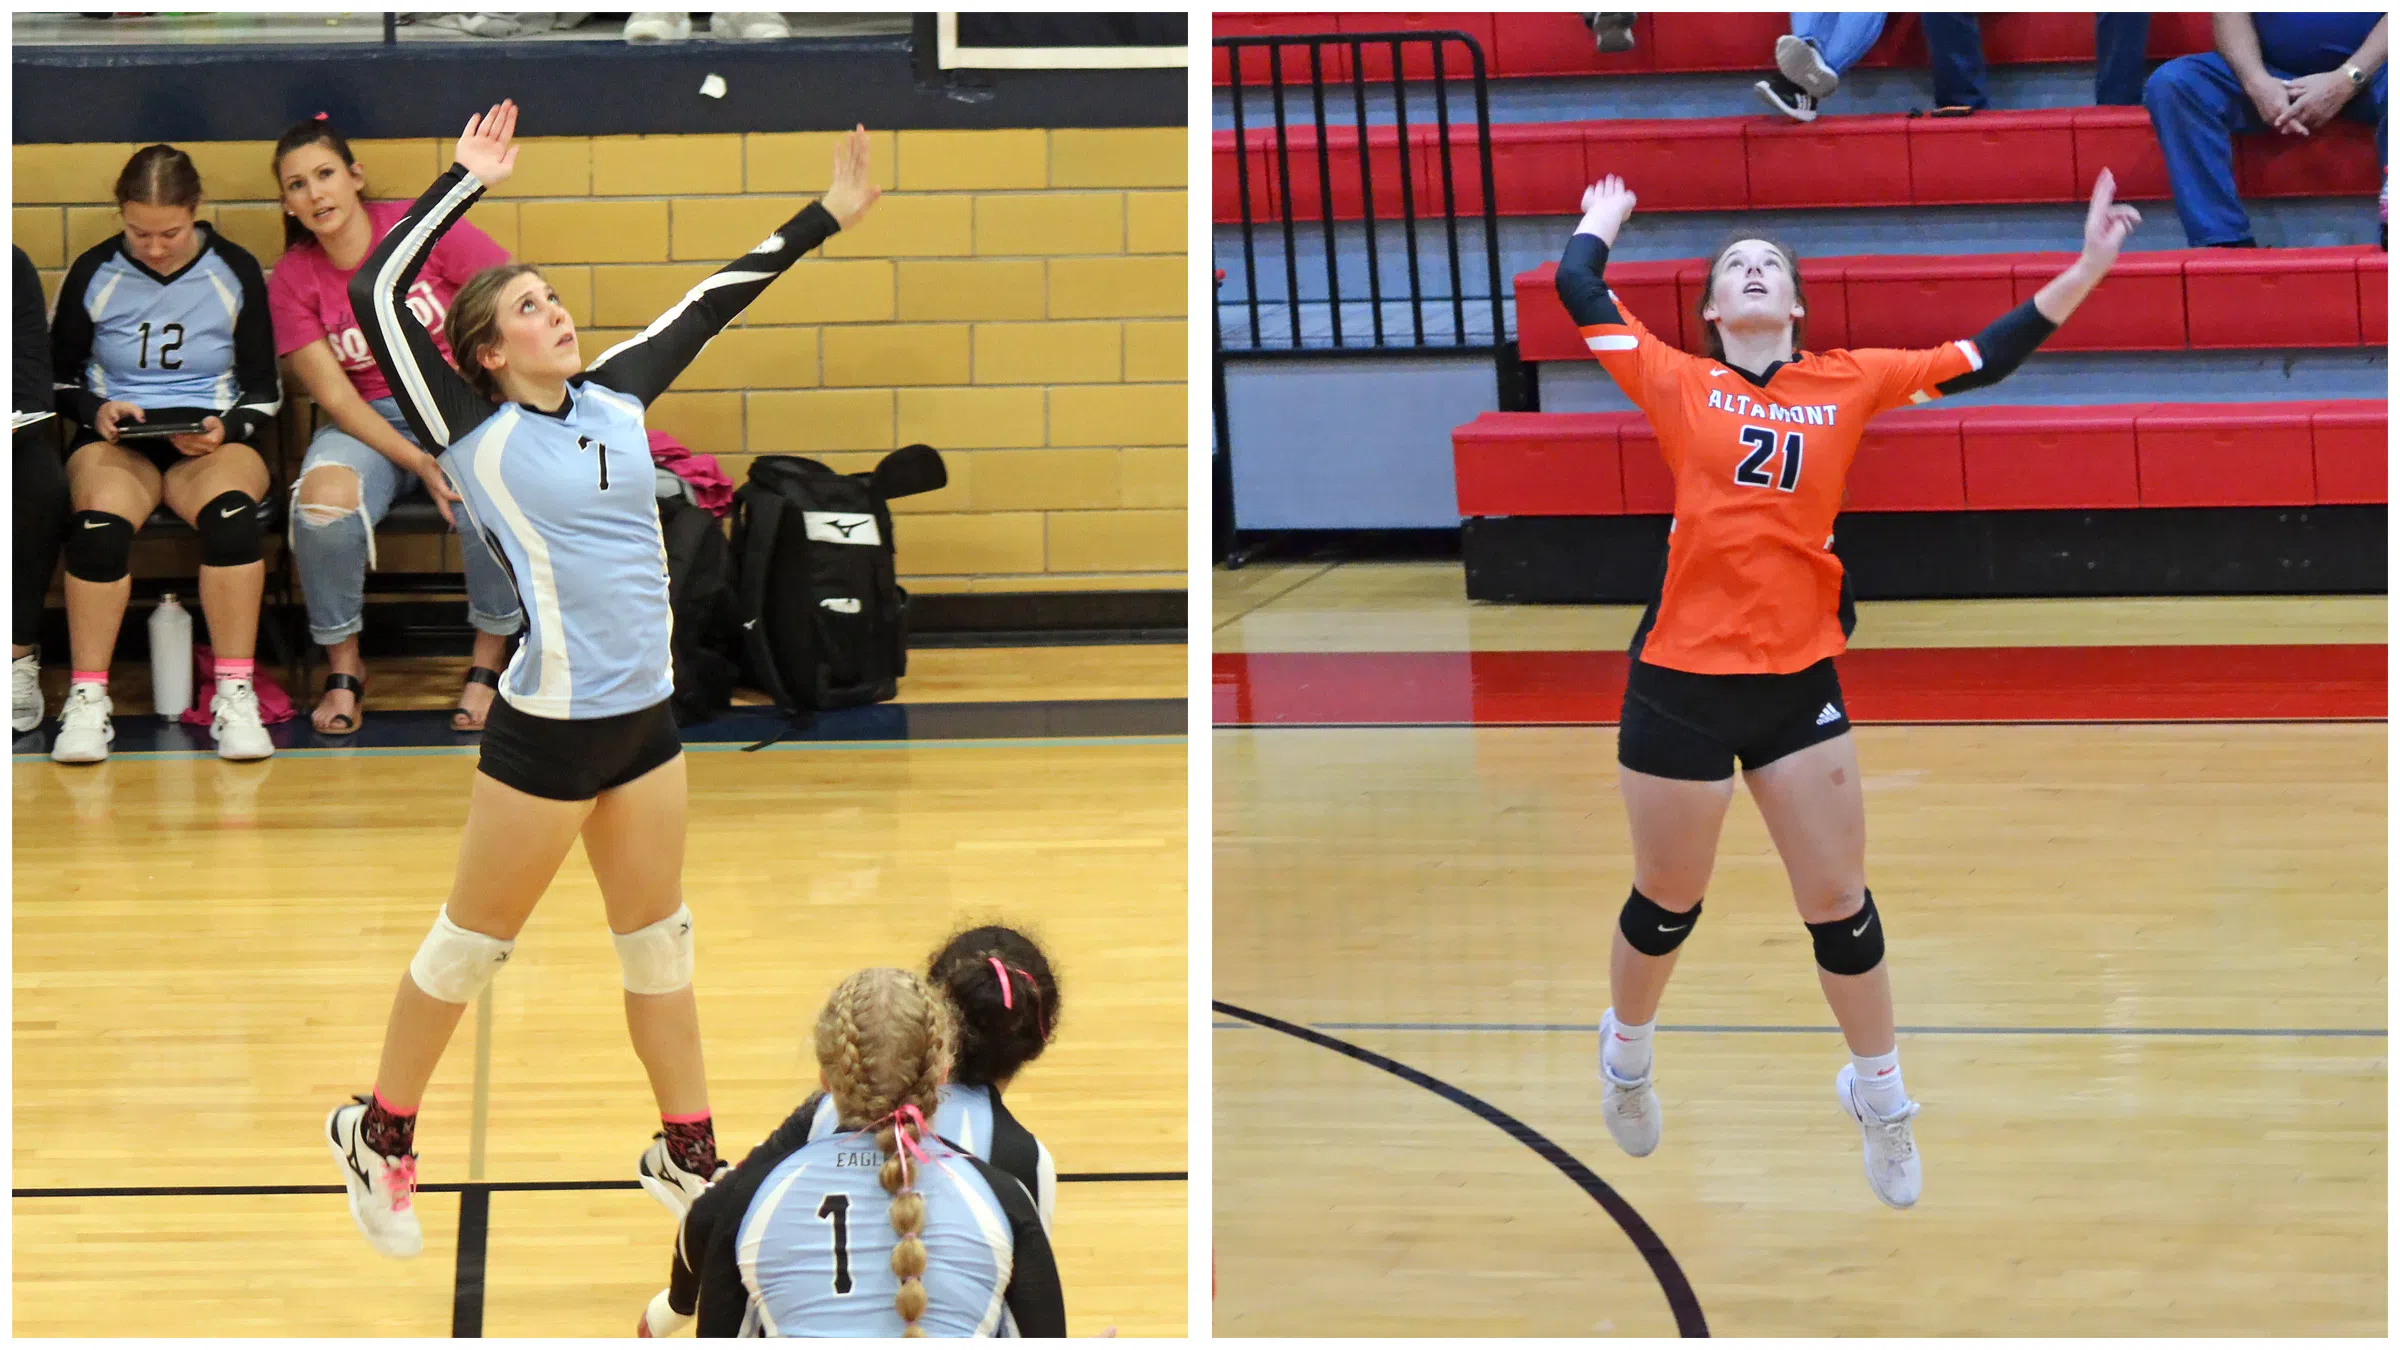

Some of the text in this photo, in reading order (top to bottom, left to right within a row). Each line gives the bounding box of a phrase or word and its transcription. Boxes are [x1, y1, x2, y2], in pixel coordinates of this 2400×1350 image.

[138, 322, 184, 370] 12
[1707, 389, 1837, 426] ALTAMONT
[576, 433, 610, 491] 7
[1734, 424, 1804, 493] 21
[836, 1151, 882, 1168] EAGL
[816, 1192, 855, 1297] 1
